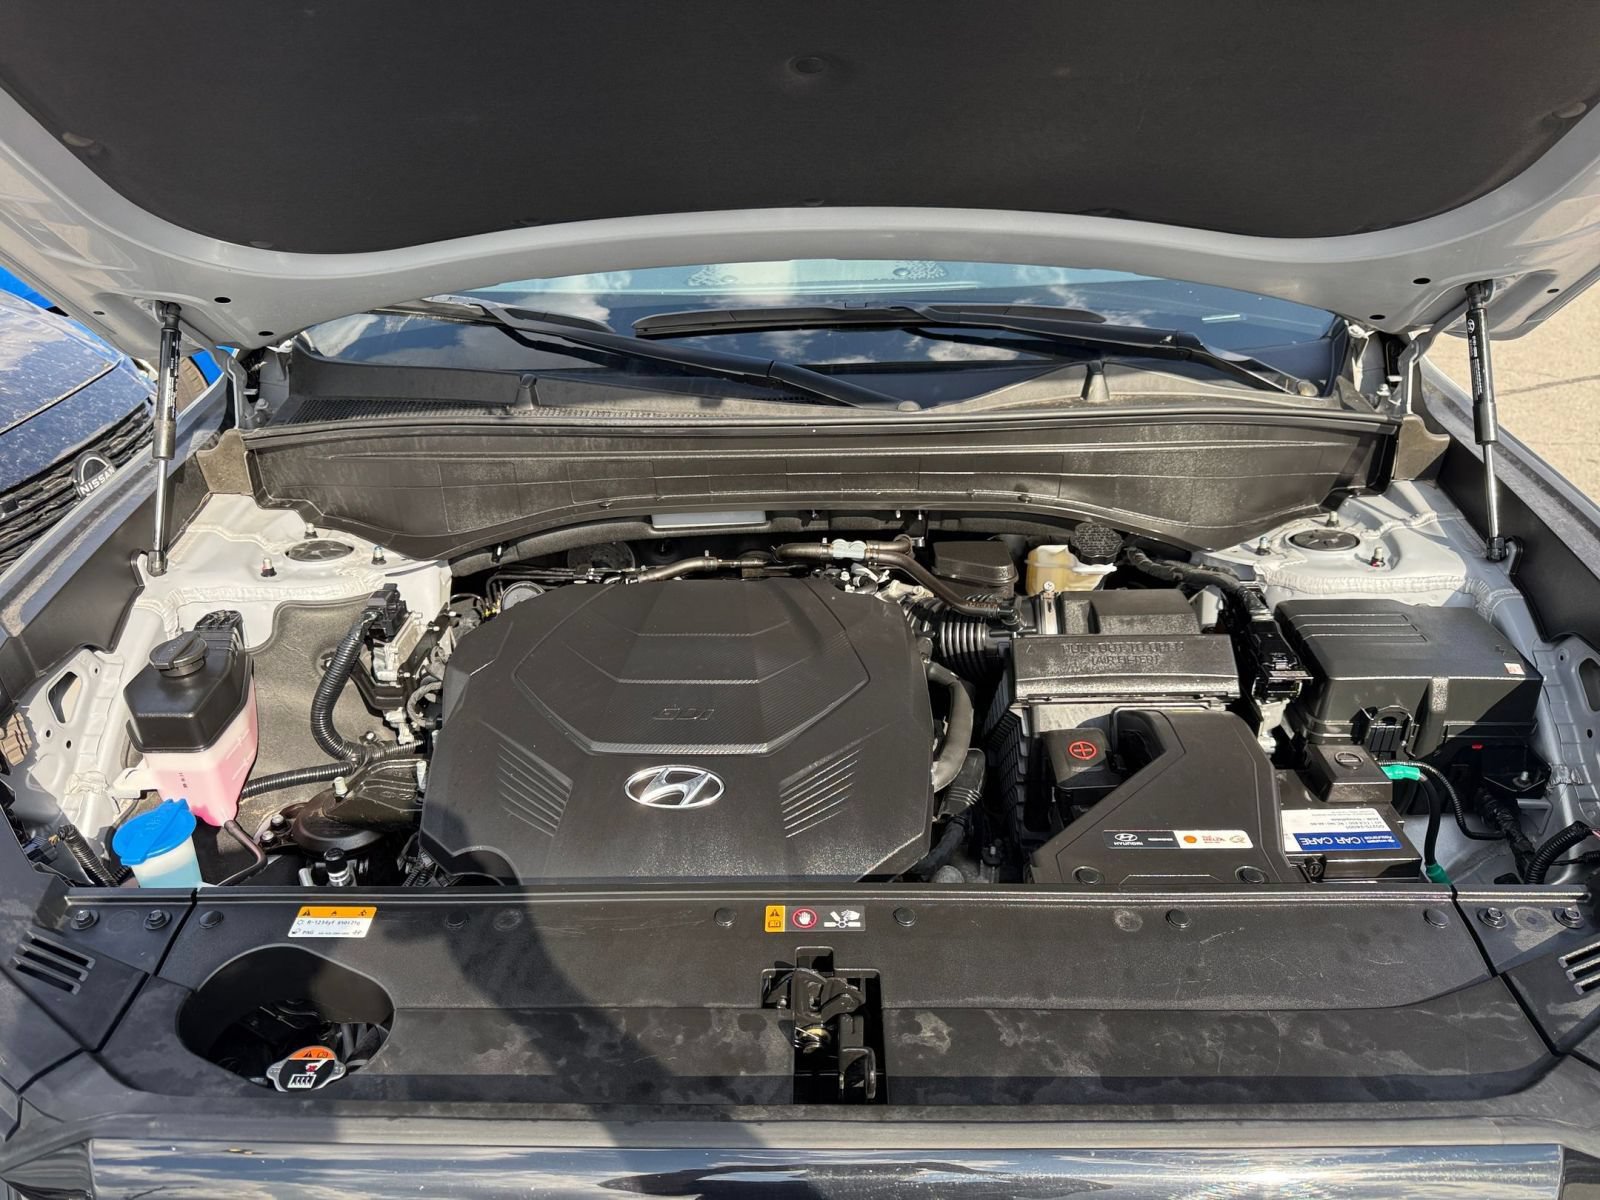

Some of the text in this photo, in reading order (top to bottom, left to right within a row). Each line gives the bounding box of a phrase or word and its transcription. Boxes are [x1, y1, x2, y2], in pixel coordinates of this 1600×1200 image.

[80, 465, 115, 495] NISSAN
[1300, 837, 1335, 846] CARE
[1336, 836, 1362, 845] CAR
